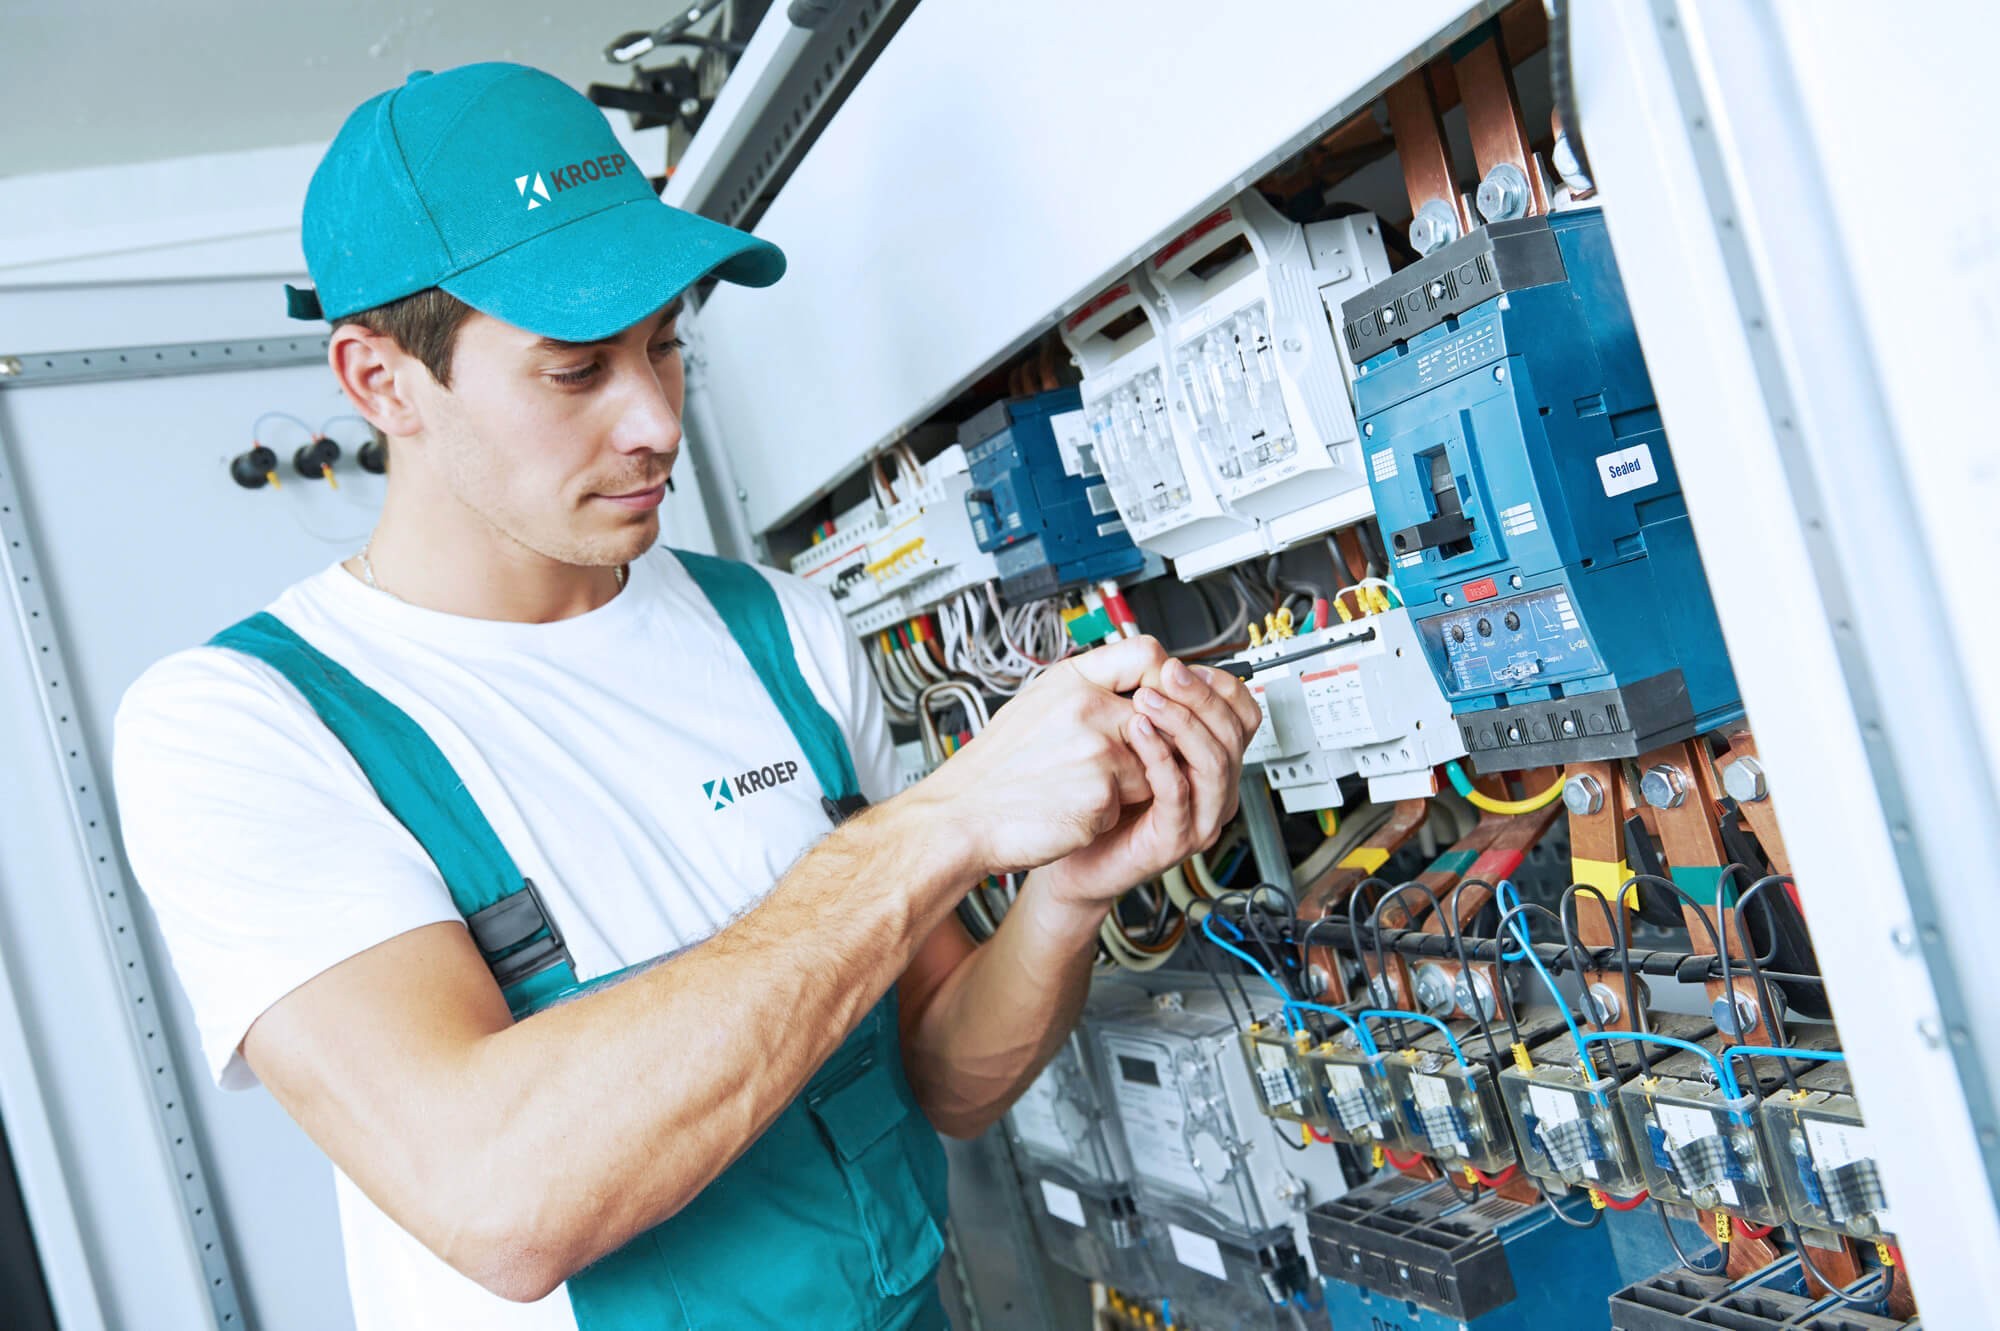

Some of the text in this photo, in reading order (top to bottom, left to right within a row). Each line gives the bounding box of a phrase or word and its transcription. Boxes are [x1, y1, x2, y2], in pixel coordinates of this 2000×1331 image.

[550, 153, 627, 193] KROEP
[1608, 457, 1641, 479] Sealed
[733, 760, 799, 797] KROEP
